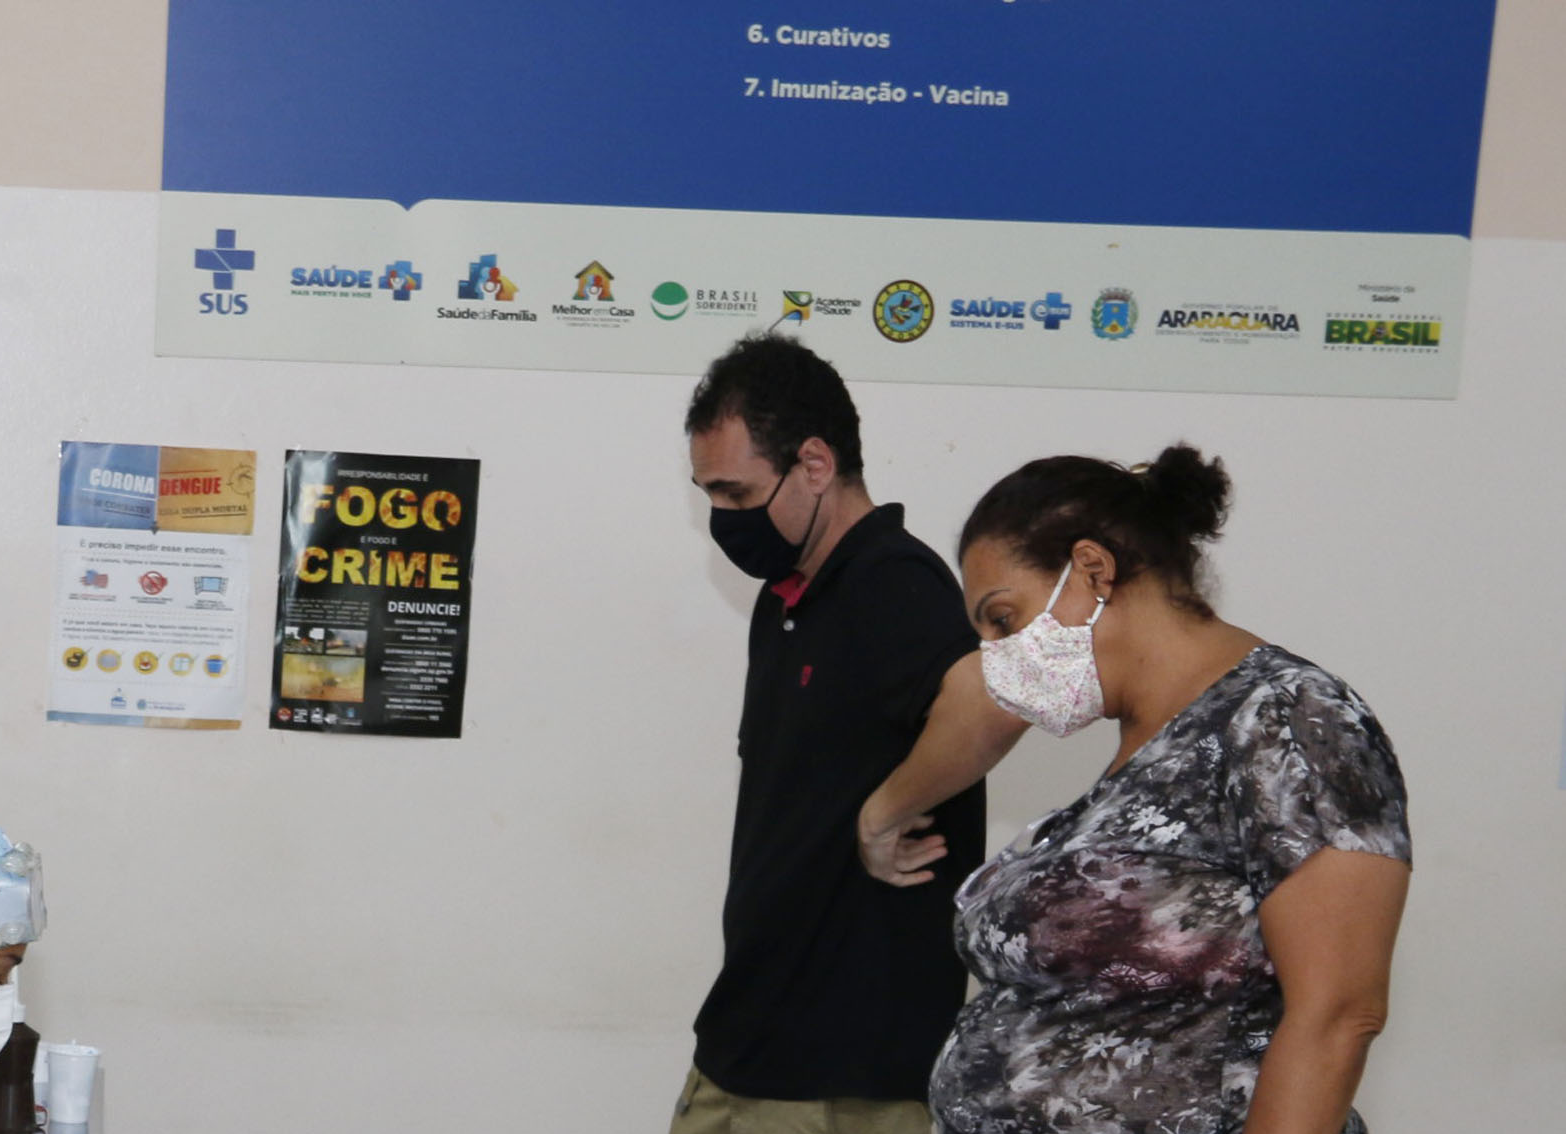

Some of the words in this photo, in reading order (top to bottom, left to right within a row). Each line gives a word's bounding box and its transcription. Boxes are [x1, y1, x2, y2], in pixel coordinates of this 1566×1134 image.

[747, 24, 768, 44] 6.
[776, 25, 890, 48] Curativos
[744, 78, 765, 97] 7.
[772, 79, 907, 104] Imunização
[929, 84, 1009, 106] Vacina
[291, 265, 372, 289] SAÚDE
[198, 293, 249, 315] SUS
[695, 301, 757, 312] SORRIDENTE
[696, 289, 758, 303] BRASIL
[815, 297, 861, 307] Academia
[552, 304, 592, 316] Melhor
[609, 306, 635, 317] Casa
[950, 297, 1026, 318] SAÚDE
[950, 319, 992, 329] SISTEMA
[995, 321, 1025, 330] E-SUS
[1157, 309, 1300, 332] ARARAQUARA
[1325, 319, 1439, 346] BRASIL
[89, 468, 154, 494] CORONA
[159, 477, 222, 496] DENGUE
[301, 484, 462, 531] FOGO
[89, 541, 122, 550] preciso
[124, 542, 159, 552] impedir
[367, 537, 389, 545] FOGO
[297, 546, 460, 590] CRIME
[388, 601, 461, 616] DENUNCIE!
